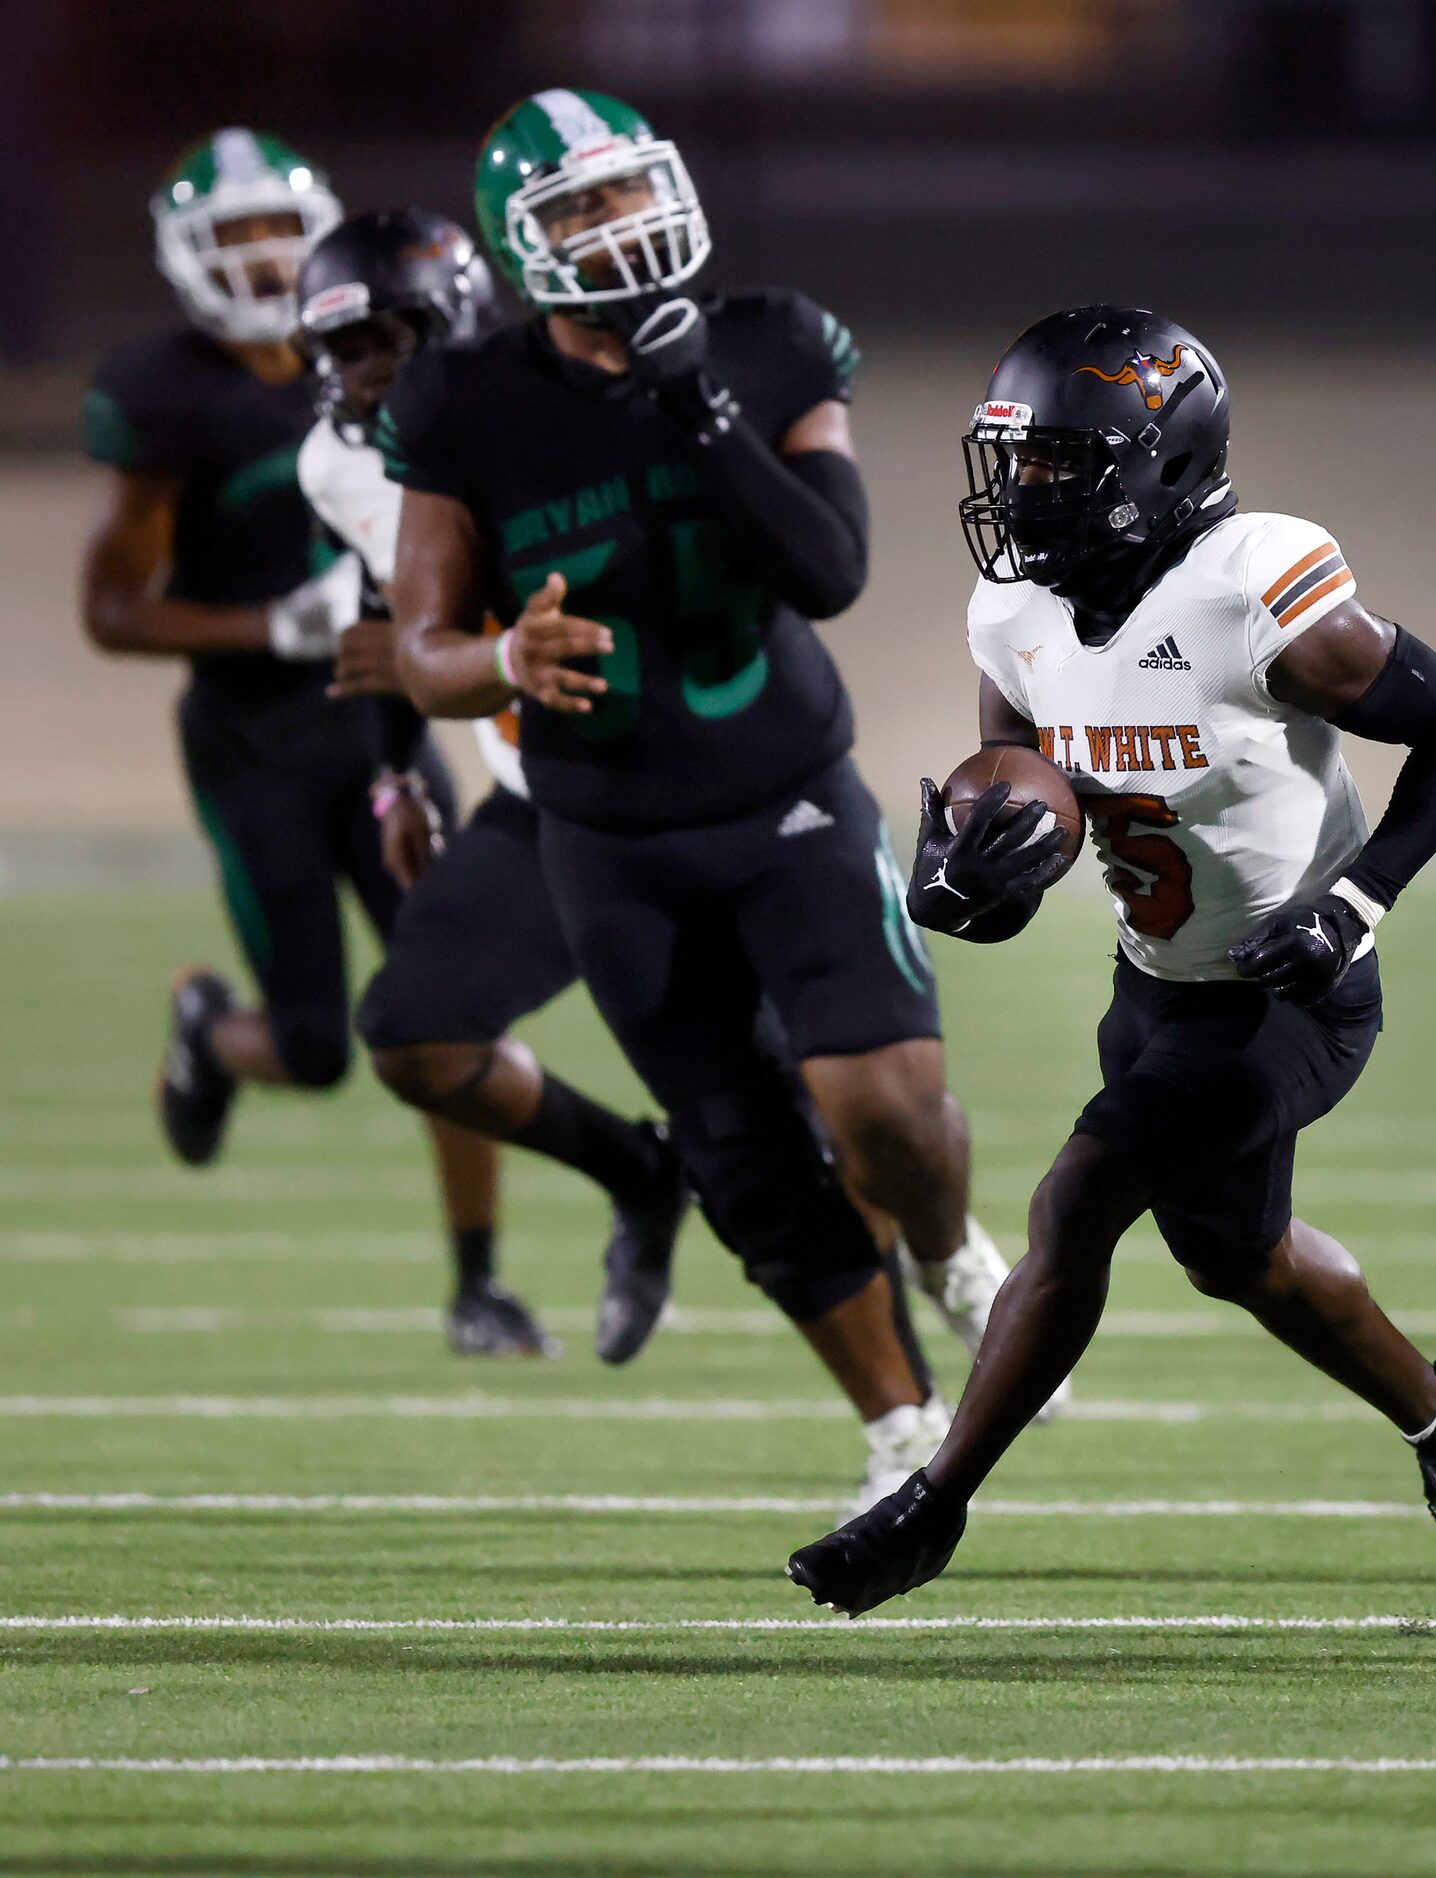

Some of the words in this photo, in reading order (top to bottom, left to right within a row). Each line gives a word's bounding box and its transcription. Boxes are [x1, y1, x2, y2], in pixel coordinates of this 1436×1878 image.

[1139, 657, 1192, 671] adidas
[1084, 724, 1210, 772] WHITE
[1085, 792, 1196, 941] 5
